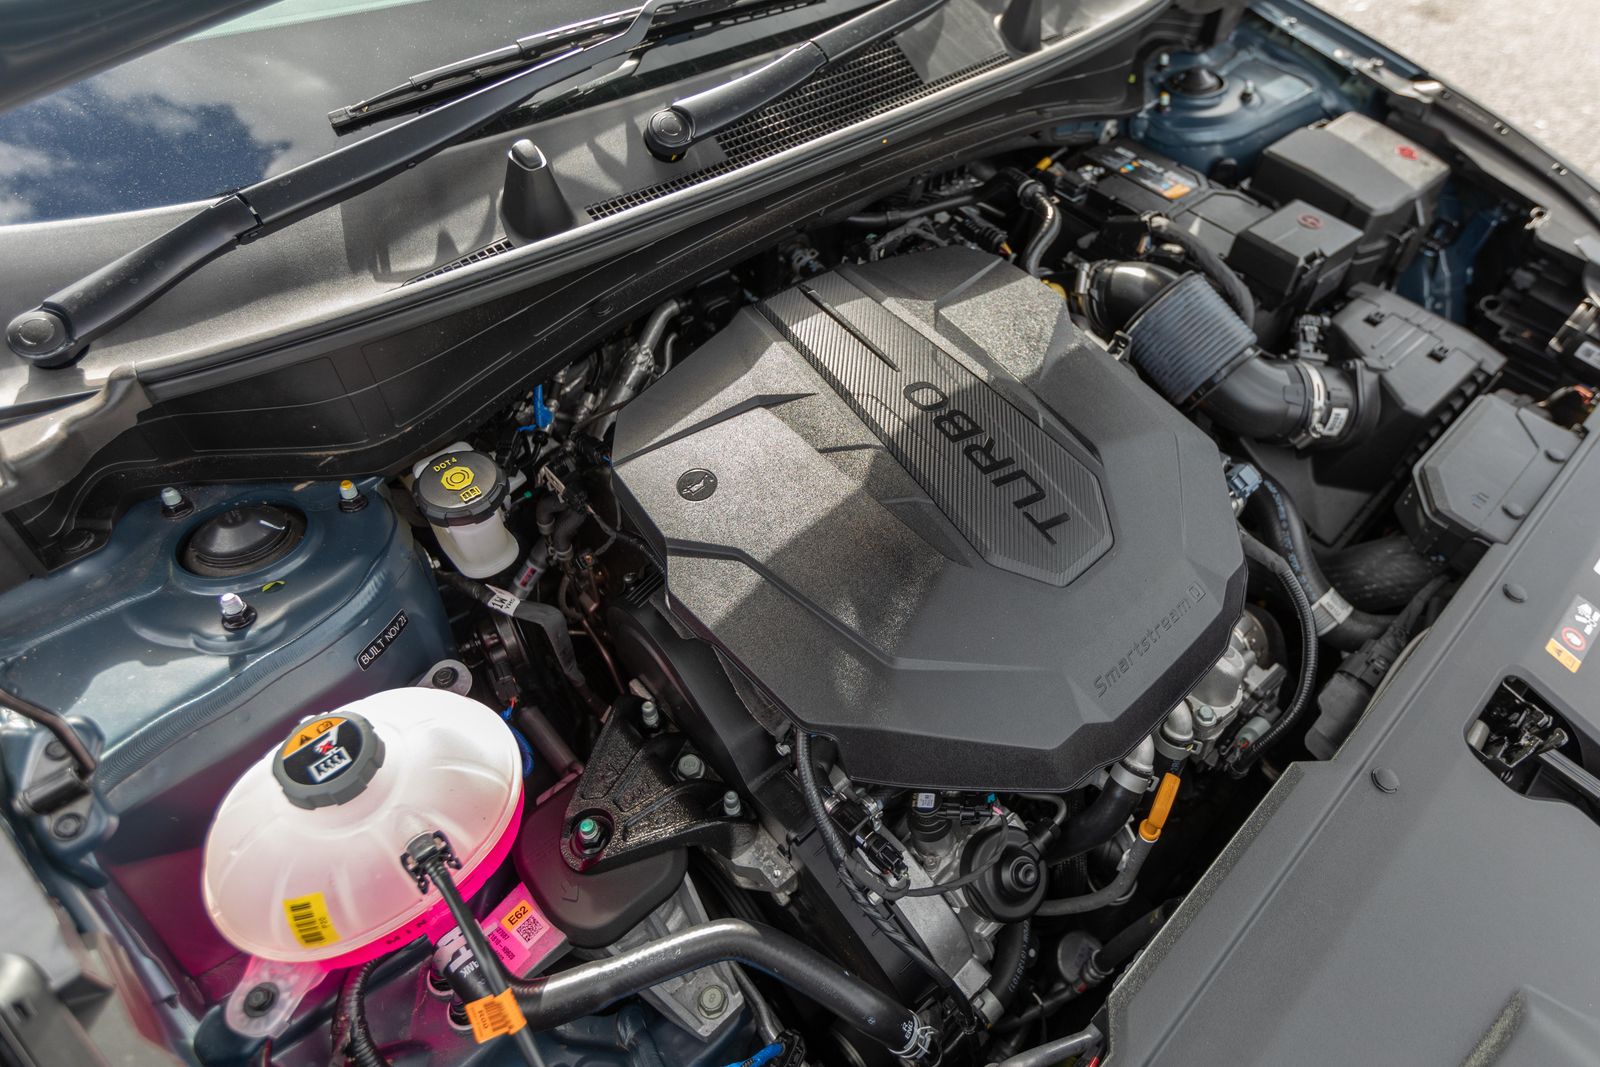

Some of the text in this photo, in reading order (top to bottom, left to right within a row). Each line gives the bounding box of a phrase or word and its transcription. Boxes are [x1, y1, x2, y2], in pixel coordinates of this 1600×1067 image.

[903, 381, 1072, 545] TURBO
[360, 639, 385, 665] BUILT
[384, 622, 401, 642] NOV
[1093, 598, 1192, 698] Smartstream
[508, 905, 529, 926] E62
[904, 1020, 914, 1040] ENG
